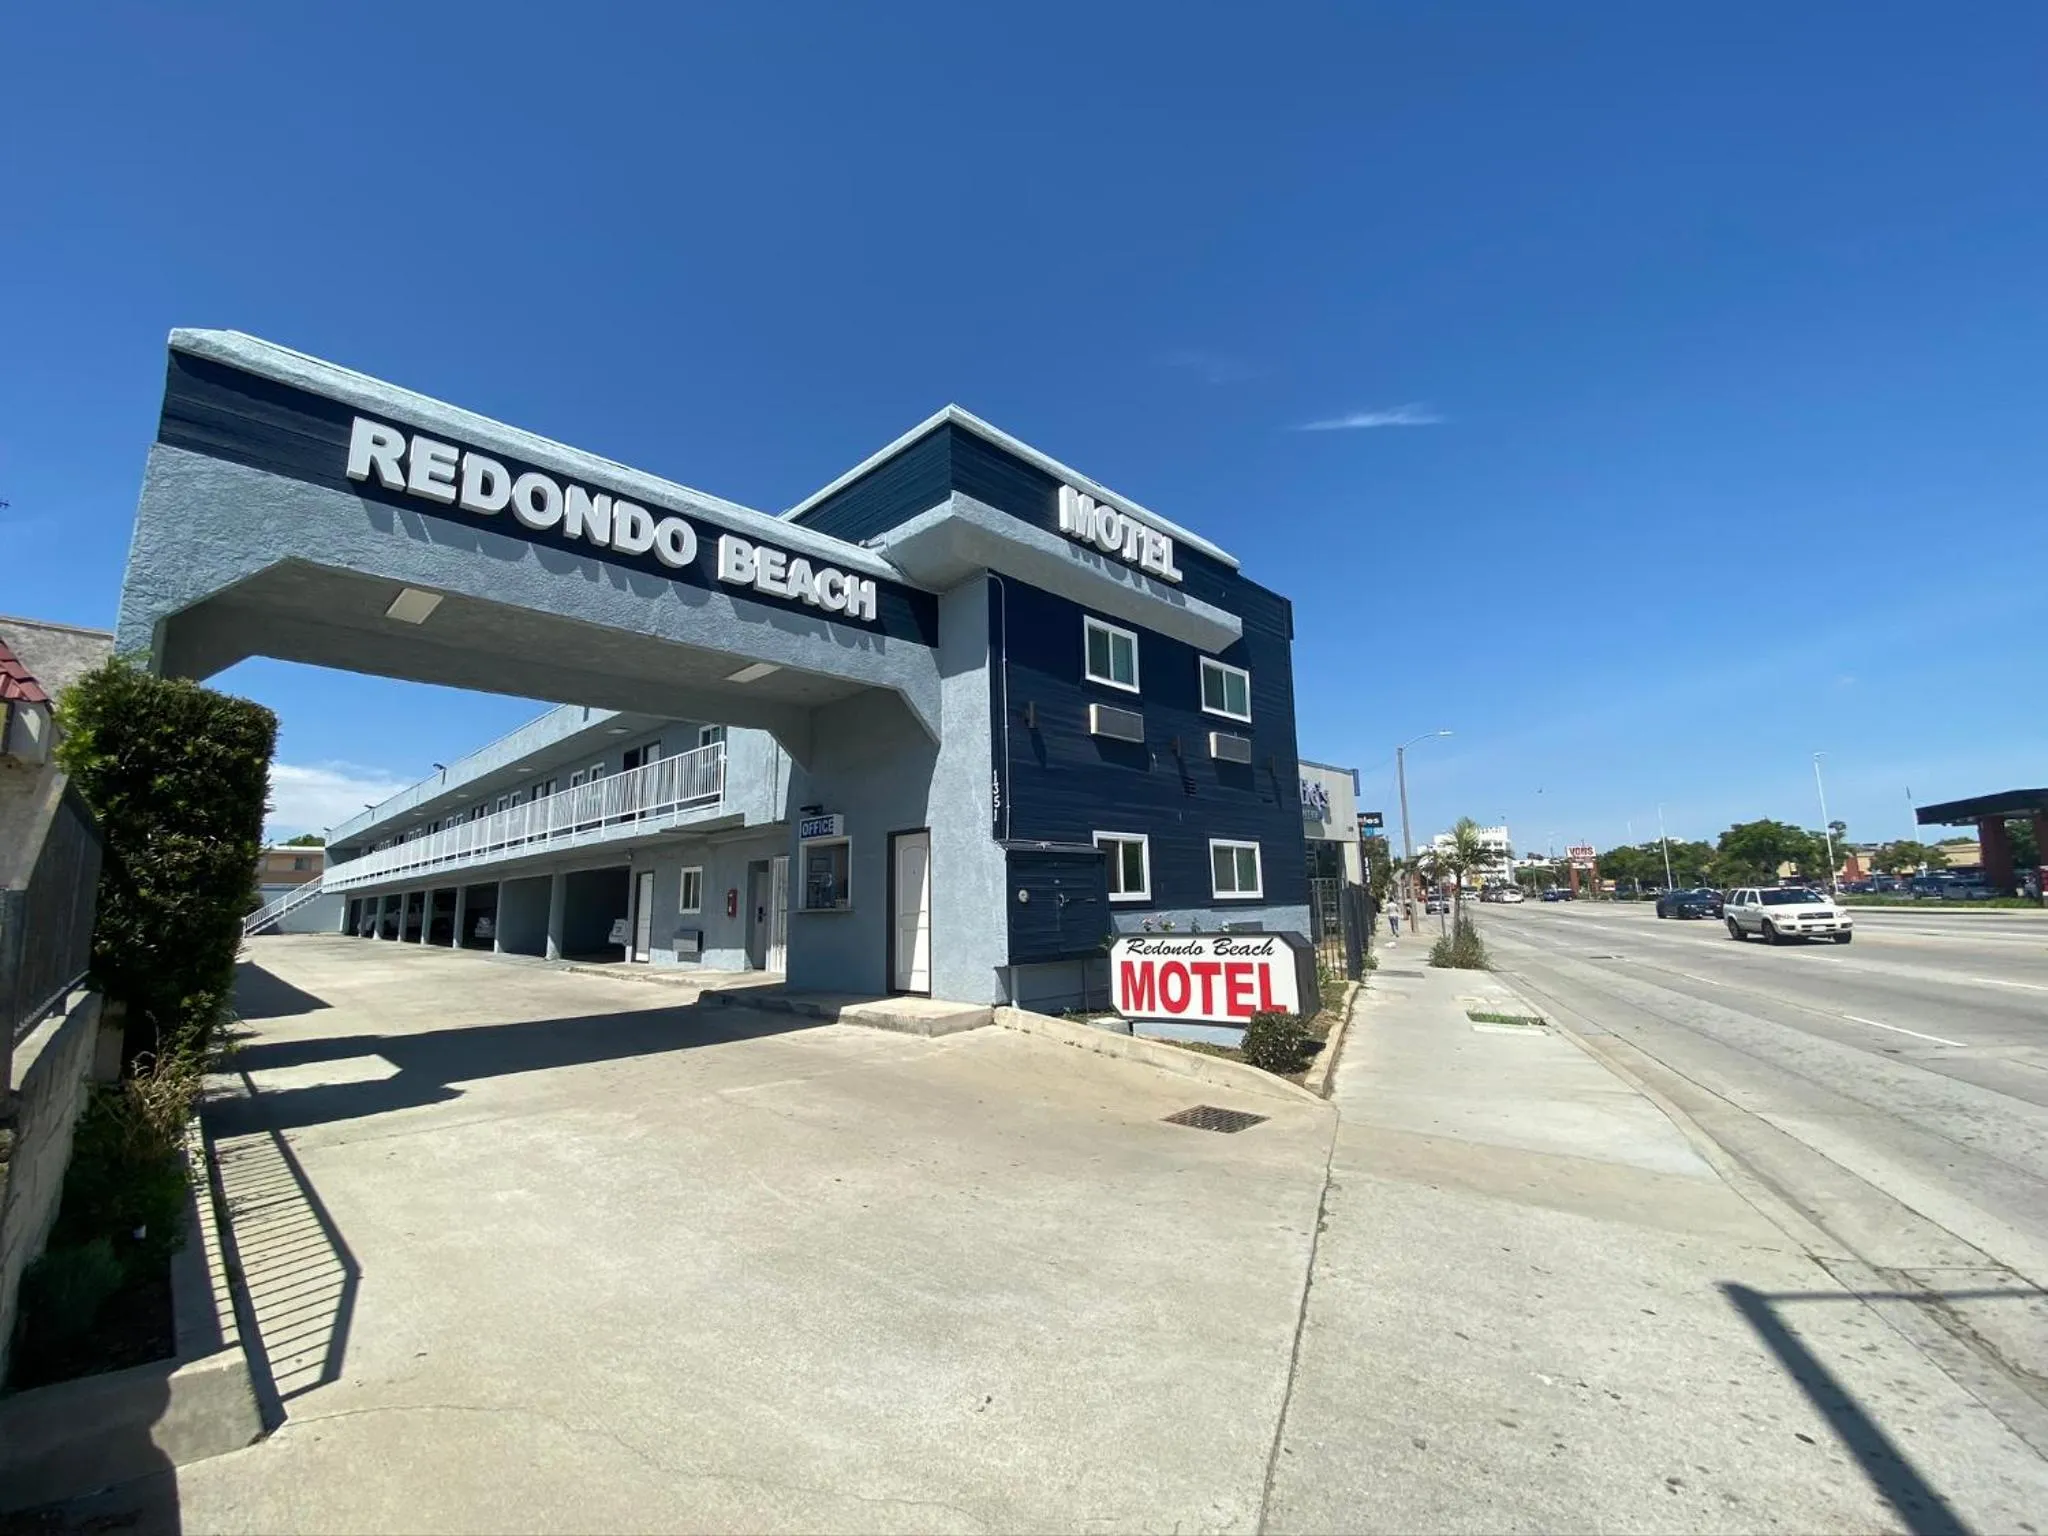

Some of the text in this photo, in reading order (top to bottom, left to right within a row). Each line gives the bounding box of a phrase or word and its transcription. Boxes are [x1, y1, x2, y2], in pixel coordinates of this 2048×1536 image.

[346, 417, 876, 621] REDONDO BEACH
[1059, 485, 1183, 583] MOTEL
[803, 819, 834, 836] OFFICE
[1126, 937, 1275, 956] Redondo Beach
[1120, 960, 1287, 1017] MOTEL
